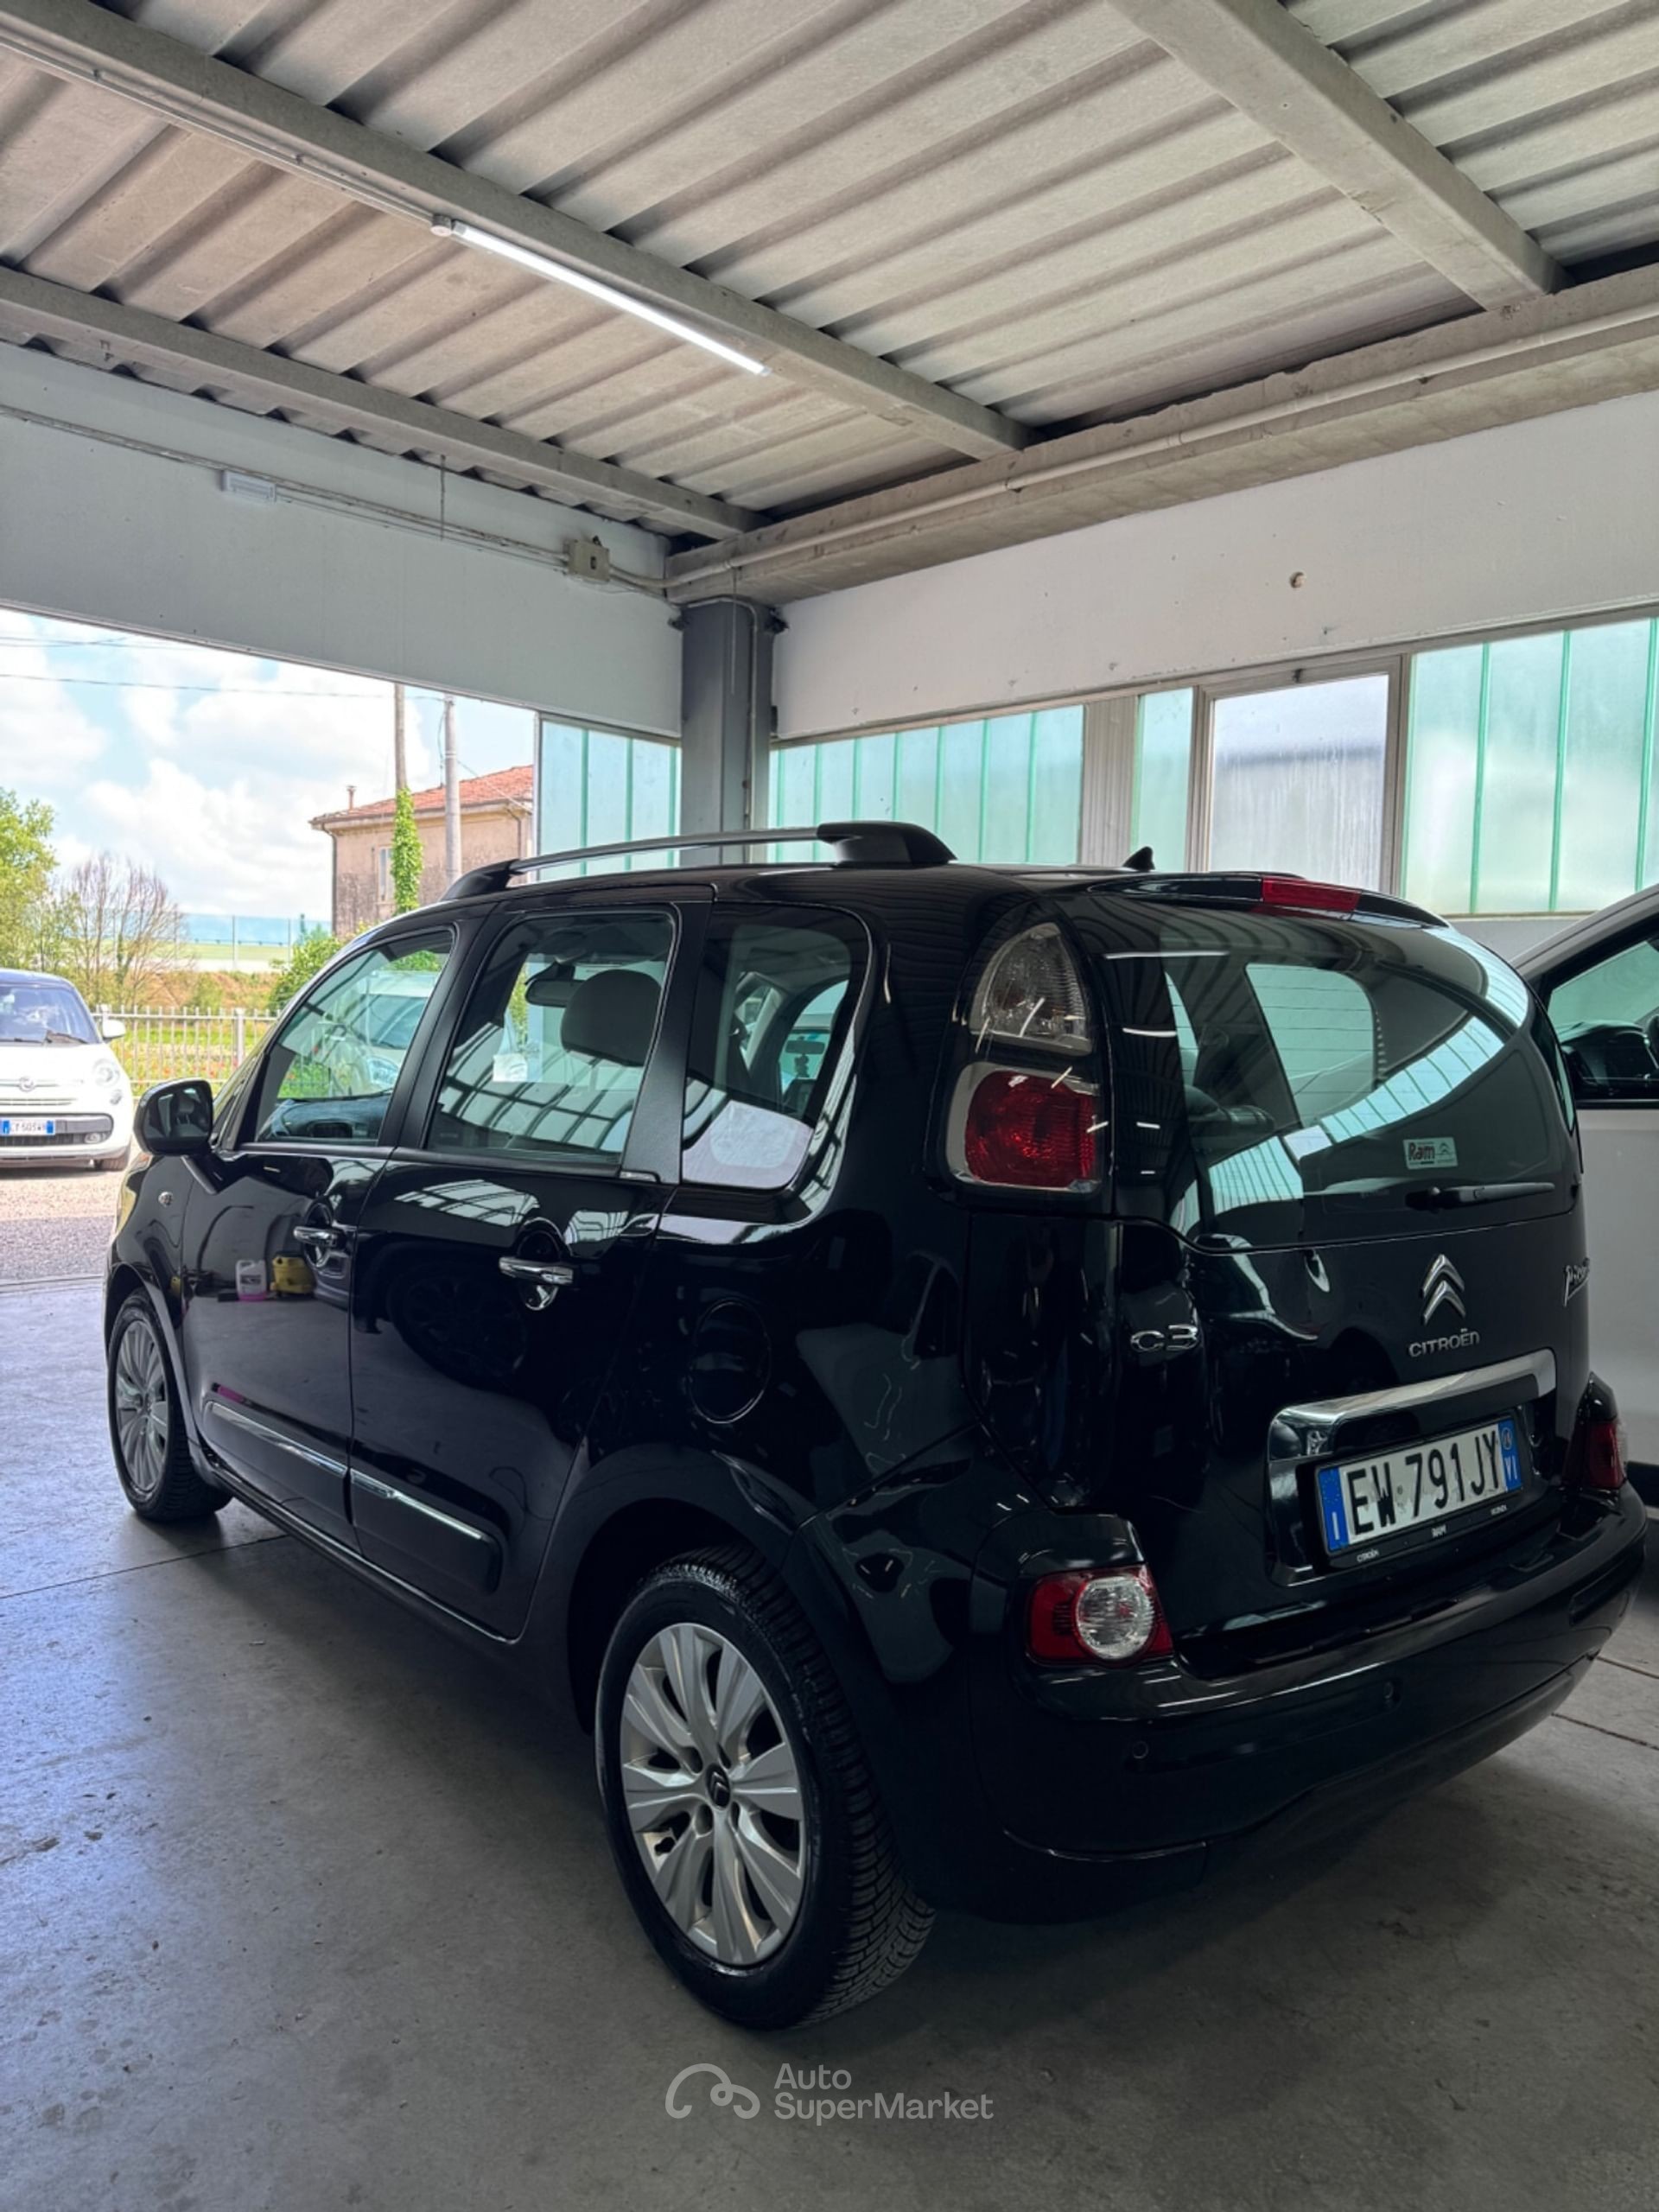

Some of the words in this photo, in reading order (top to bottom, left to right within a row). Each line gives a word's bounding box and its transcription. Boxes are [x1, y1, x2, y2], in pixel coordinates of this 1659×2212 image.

[1408, 1142, 1435, 1160] Ram
[1130, 1324, 1198, 1353] C3
[1346, 1461, 1396, 1535] EW
[1404, 1430, 1500, 1518] 791JY
[1503, 1455, 1518, 1482] VI
